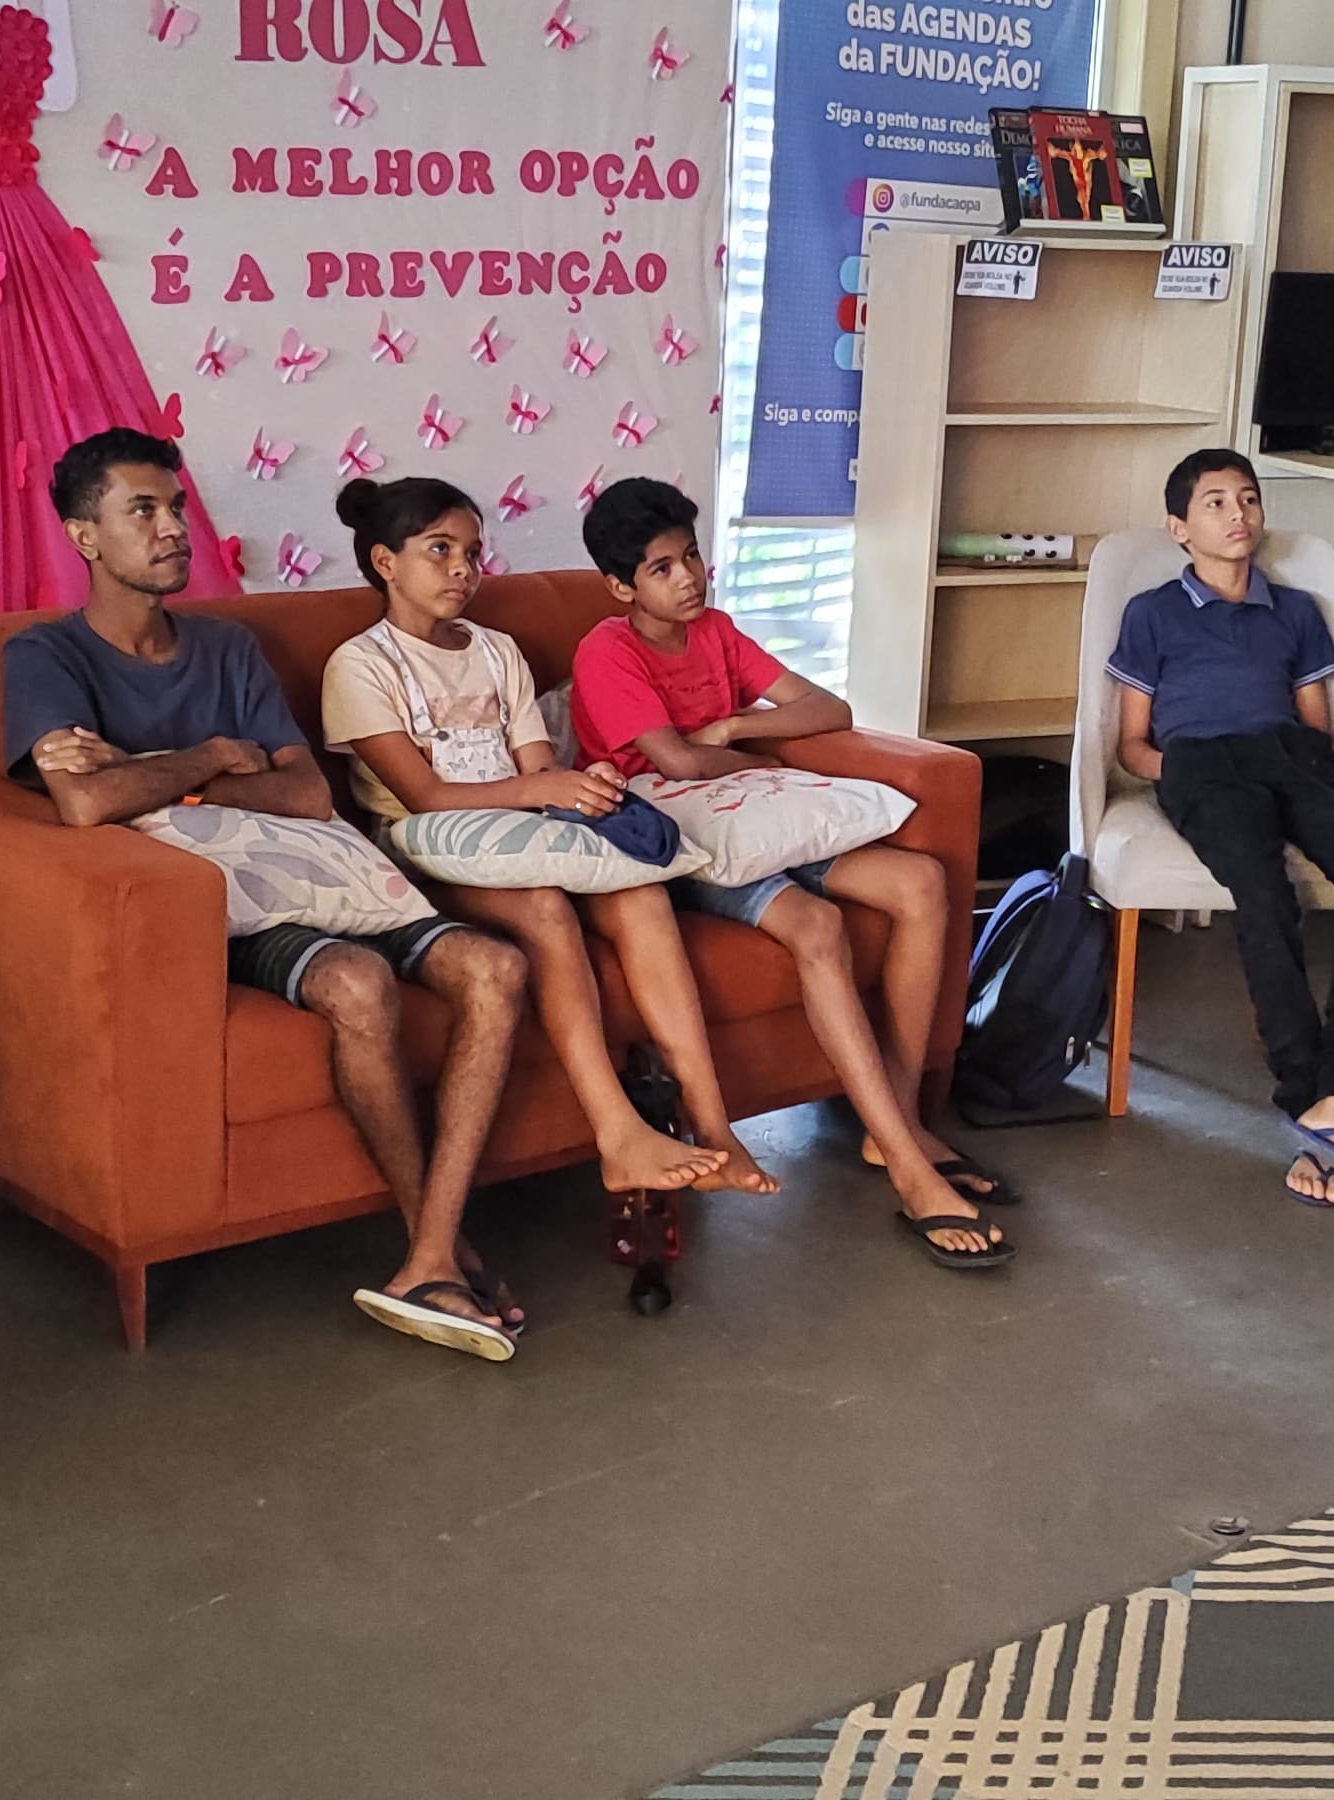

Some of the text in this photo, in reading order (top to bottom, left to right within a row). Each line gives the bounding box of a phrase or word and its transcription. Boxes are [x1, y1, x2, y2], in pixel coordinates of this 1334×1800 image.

[234, 0, 486, 67] ROSA
[847, 0, 1033, 49] das AGENDAS
[838, 38, 1042, 95] da FUNDAÇÃO!
[825, 101, 991, 137] Siga a gente nas redes
[864, 132, 874, 148] e
[876, 134, 926, 152] acesse
[928, 139, 971, 157] nosso
[145, 135, 700, 216] A MELHOR OPÇÃO
[899, 191, 982, 214] @fundacaopa
[151, 227, 668, 314] É A PREVENÇÃO
[969, 241, 1034, 265] AVISO
[1167, 246, 1227, 267] AVISO
[764, 402, 860, 429] Siga e comp
